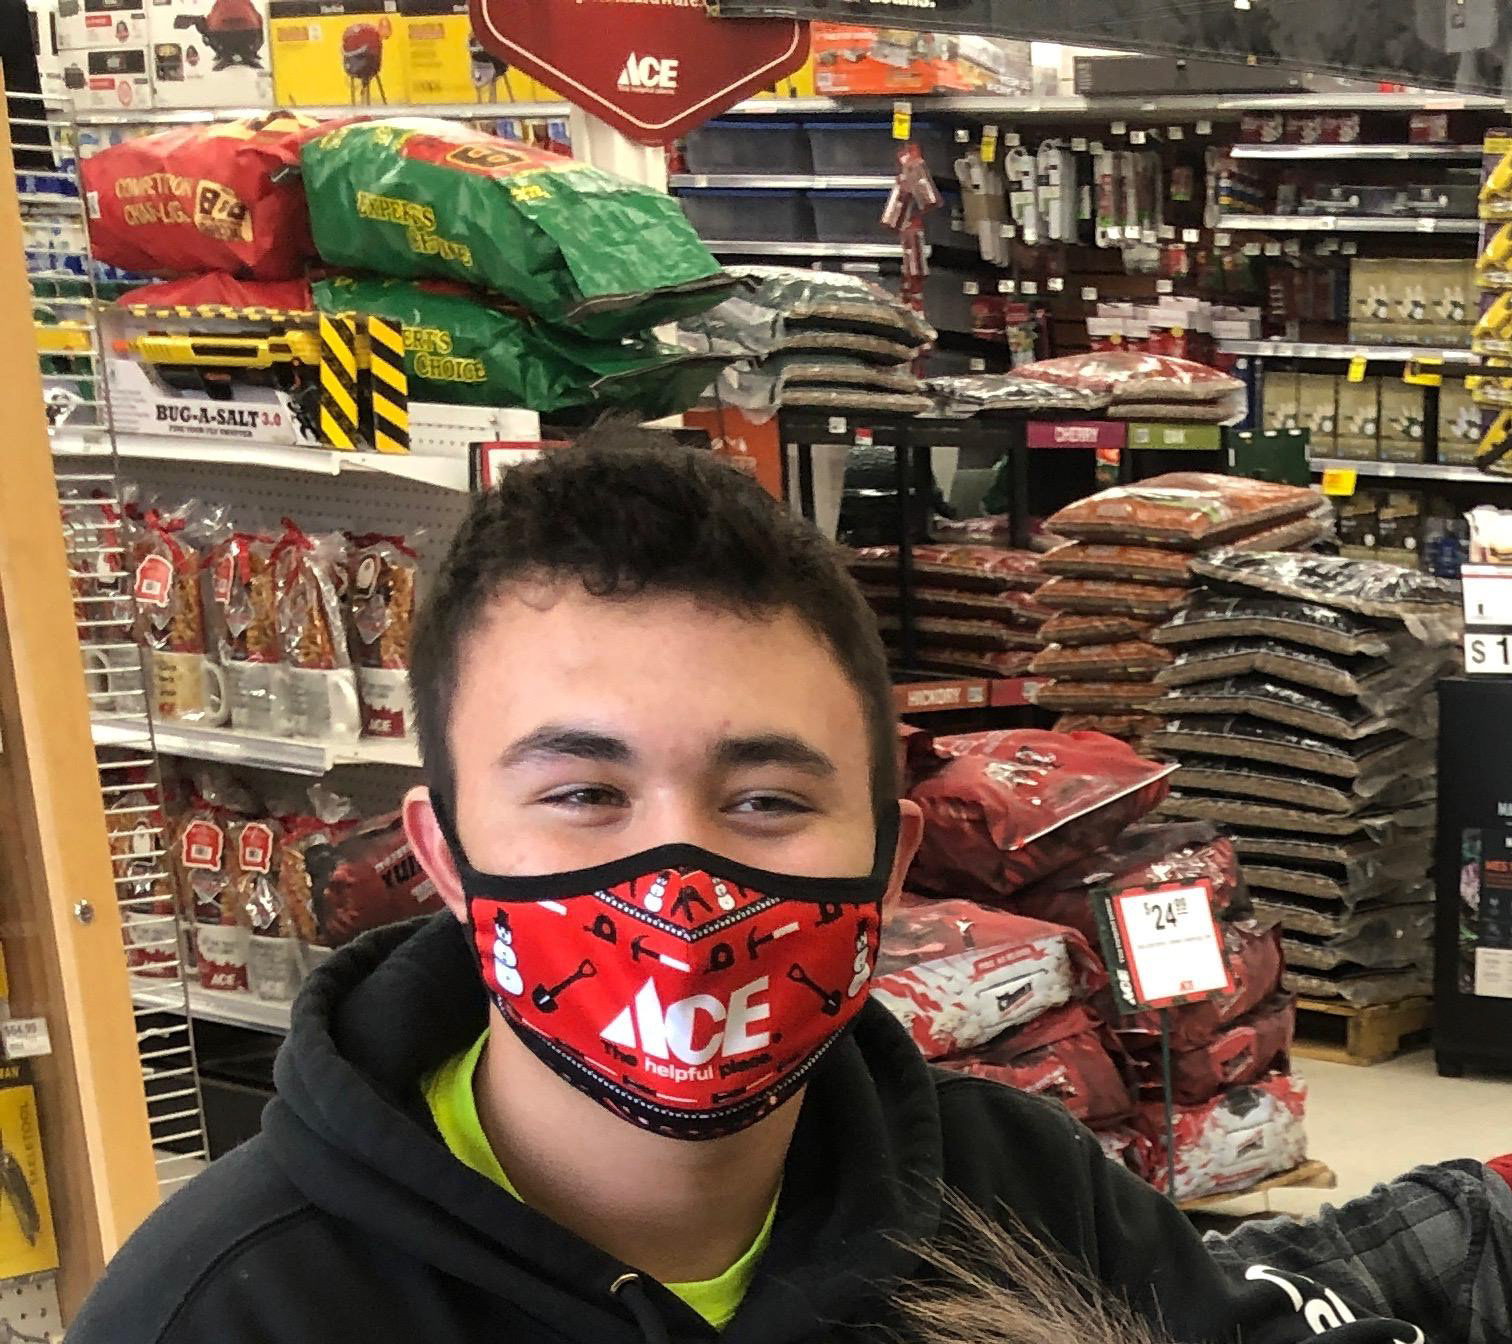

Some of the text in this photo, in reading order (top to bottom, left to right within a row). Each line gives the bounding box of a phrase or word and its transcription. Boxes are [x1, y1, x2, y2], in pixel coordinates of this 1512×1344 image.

[617, 51, 679, 88] ACE
[413, 351, 488, 383] CHOICE
[156, 403, 282, 428] BUG-A-SALT 3.0
[600, 975, 771, 1065] ACE
[644, 1056, 714, 1084] helpful
